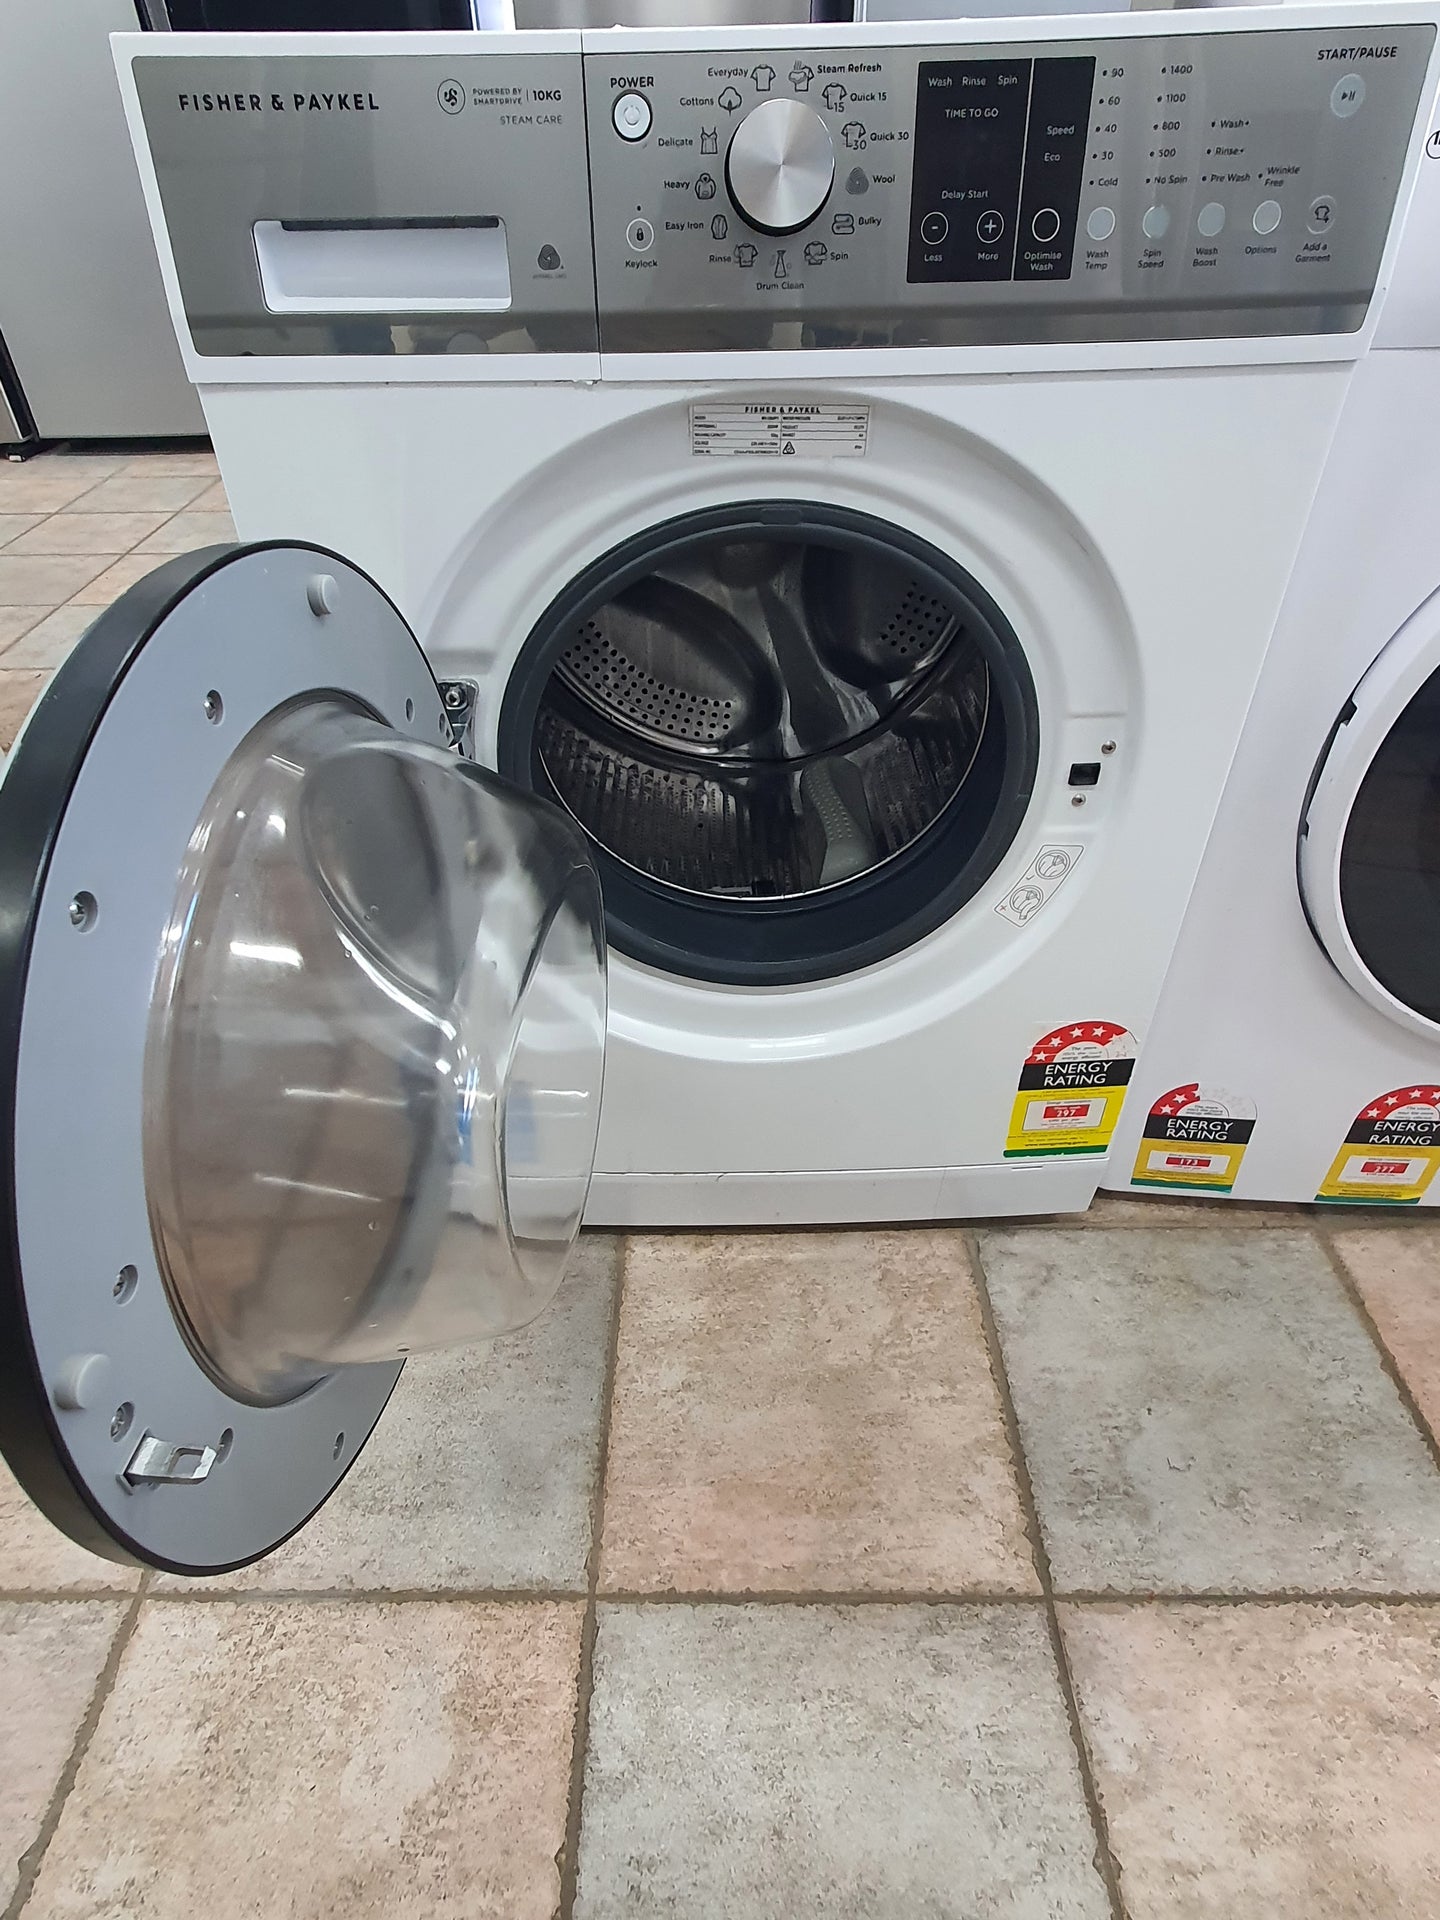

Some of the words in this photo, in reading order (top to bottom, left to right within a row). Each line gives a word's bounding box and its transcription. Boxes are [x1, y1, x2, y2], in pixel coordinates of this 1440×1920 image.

[1317, 46, 1398, 60] START/PAUSE
[707, 67, 748, 78] Everyday
[817, 64, 845, 74] Steam
[848, 63, 882, 73] Refresh
[1111, 68, 1124, 77] 90
[1170, 65, 1193, 75] 1400
[610, 76, 655, 88] POWER
[928, 77, 952, 87] Wash
[962, 76, 986, 86] Rinse
[998, 75, 1018, 86] Spin
[532, 90, 562, 101] 10KG
[850, 93, 875, 102] Quick
[878, 92, 887, 101] 15
[1108, 96, 1120, 105] 60
[1166, 93, 1186, 103] 1100
[178, 93, 262, 111] FISHER
[271, 94, 285, 111] &
[293, 93, 379, 111] PAYKEL
[680, 97, 714, 106] Cottons
[945, 108, 966, 118] TIME
[970, 108, 981, 118] TO
[984, 108, 999, 118] GO
[500, 115, 533, 125] STEAM
[536, 115, 563, 125] CARE
[1046, 125, 1075, 136] Speed
[1104, 124, 1117, 133] 40
[1162, 121, 1180, 131] 800
[870, 131, 895, 142] Quick
[898, 131, 910, 141] 30
[658, 137, 694, 147] Delicate
[1044, 152, 1061, 162] Eco
[1101, 151, 1114, 160] 30
[1158, 148, 1176, 158] 500
[1267, 166, 1300, 175] Wrinkle
[872, 174, 896, 184] Wool
[1098, 177, 1118, 187] Cold
[1154, 176, 1167, 185] No
[1168, 175, 1188, 185] Spin
[1210, 174, 1225, 182] Pre
[1227, 173, 1251, 182] Wash
[1264, 178, 1285, 187] Free
[664, 180, 690, 190] Heavy
[941, 190, 966, 201] Delay
[968, 189, 989, 199] Start
[665, 221, 685, 231] Easy
[688, 221, 704, 230] Iron
[858, 216, 882, 227] Bulky
[1196, 247, 1219, 256] Wash
[1245, 246, 1277, 255] Options
[1303, 243, 1320, 252] Add
[709, 255, 732, 263] Rinse
[830, 251, 849, 261] Spin
[924, 253, 943, 263] Less
[978, 252, 999, 261] More
[1024, 251, 1062, 261] Optimise
[1086, 250, 1109, 259] Wash
[1143, 249, 1162, 259] Spin
[1295, 254, 1331, 263] Garment
[625, 260, 658, 269] Keylock
[1030, 262, 1053, 271] Wash
[1085, 261, 1108, 271] Temp
[1138, 260, 1164, 269] Speed
[1192, 258, 1217, 267] Boost
[756, 282, 779, 290] Drum
[781, 281, 804, 290] Clean
[788, 406, 821, 414] PAYKEL
[1045, 1061, 1113, 1075] ENERGY
[1043, 1074, 1107, 1087] RATING
[1167, 1118, 1234, 1131] ENERGY
[1373, 1121, 1440, 1132] ENERGY
[1166, 1129, 1228, 1141] RATING
[1368, 1134, 1433, 1146] RATING
